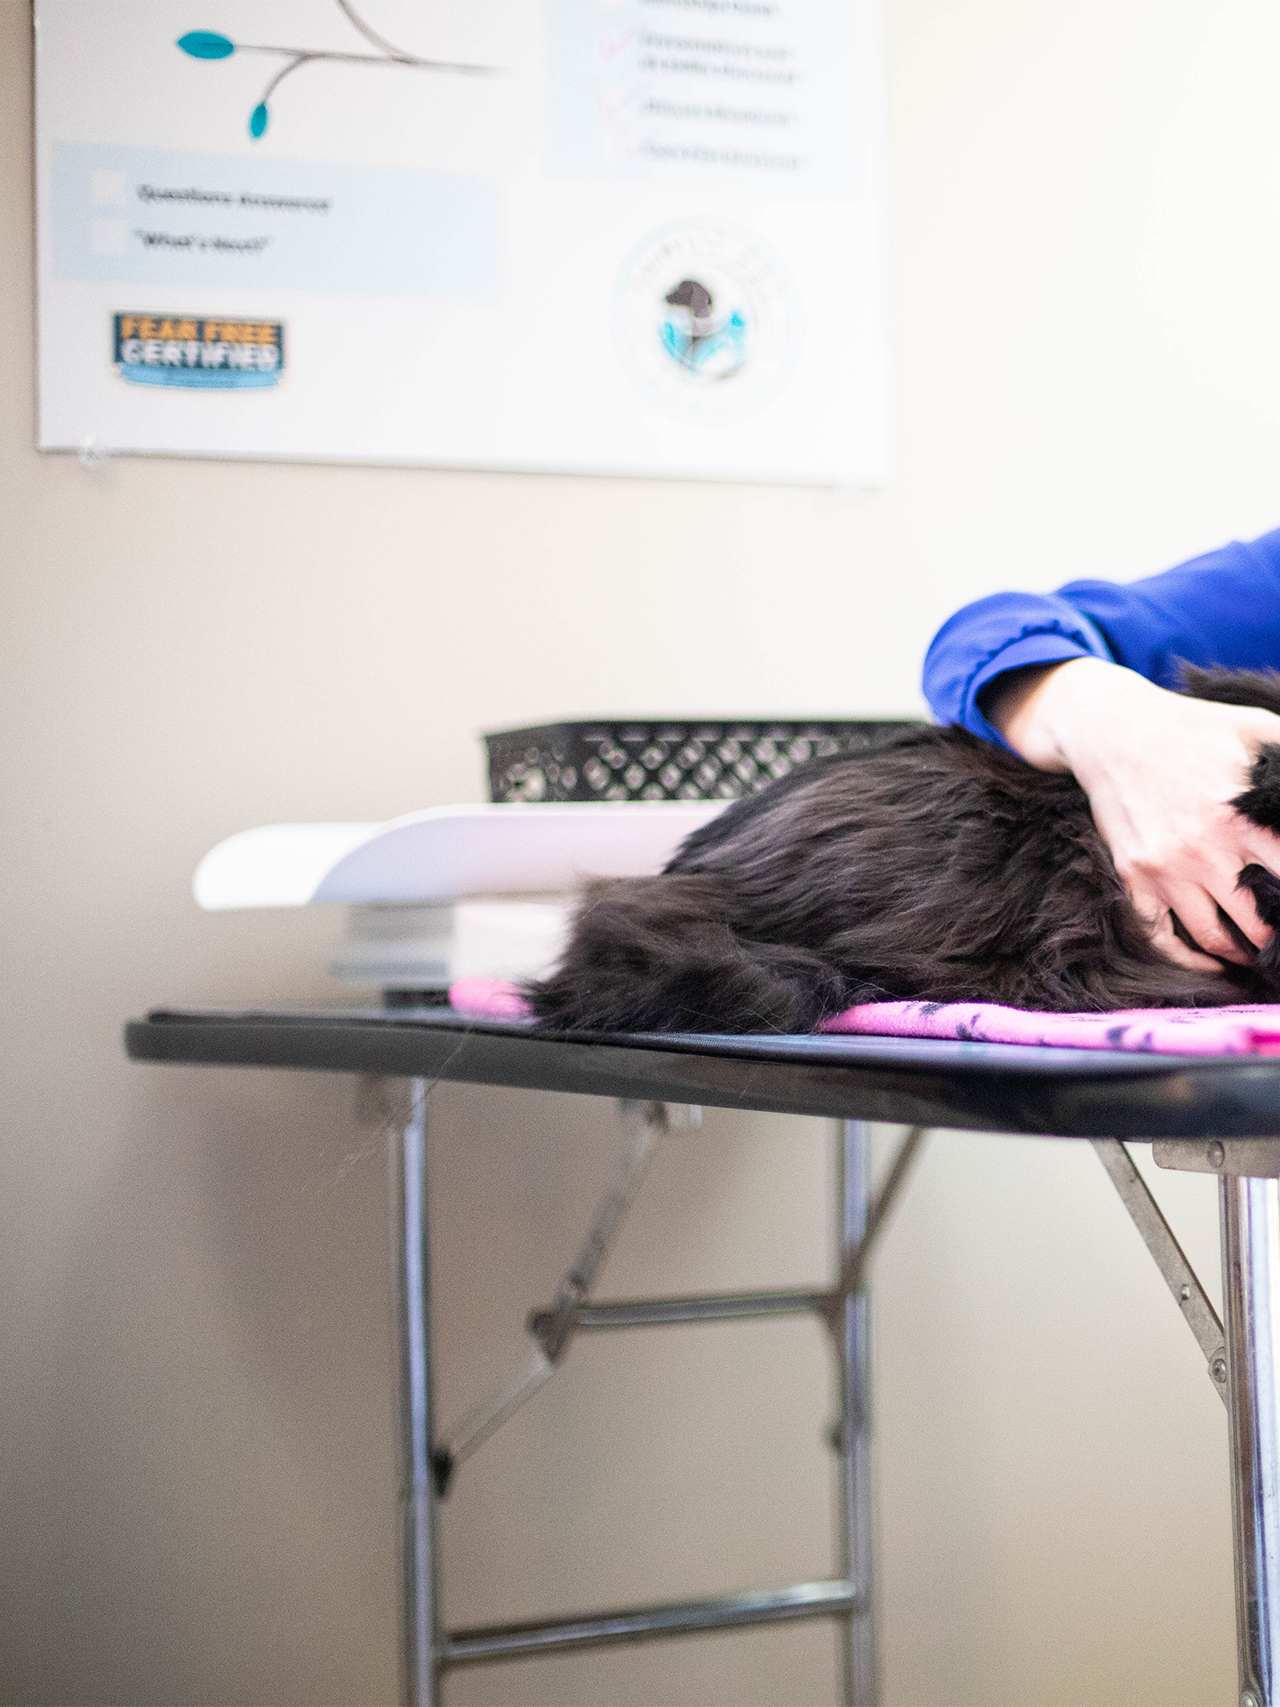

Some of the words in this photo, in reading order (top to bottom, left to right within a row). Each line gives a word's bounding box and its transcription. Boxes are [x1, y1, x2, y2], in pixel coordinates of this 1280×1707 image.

[121, 316, 197, 341] FEAR
[204, 321, 276, 345] FREE
[122, 338, 279, 371] CERTIFIED
